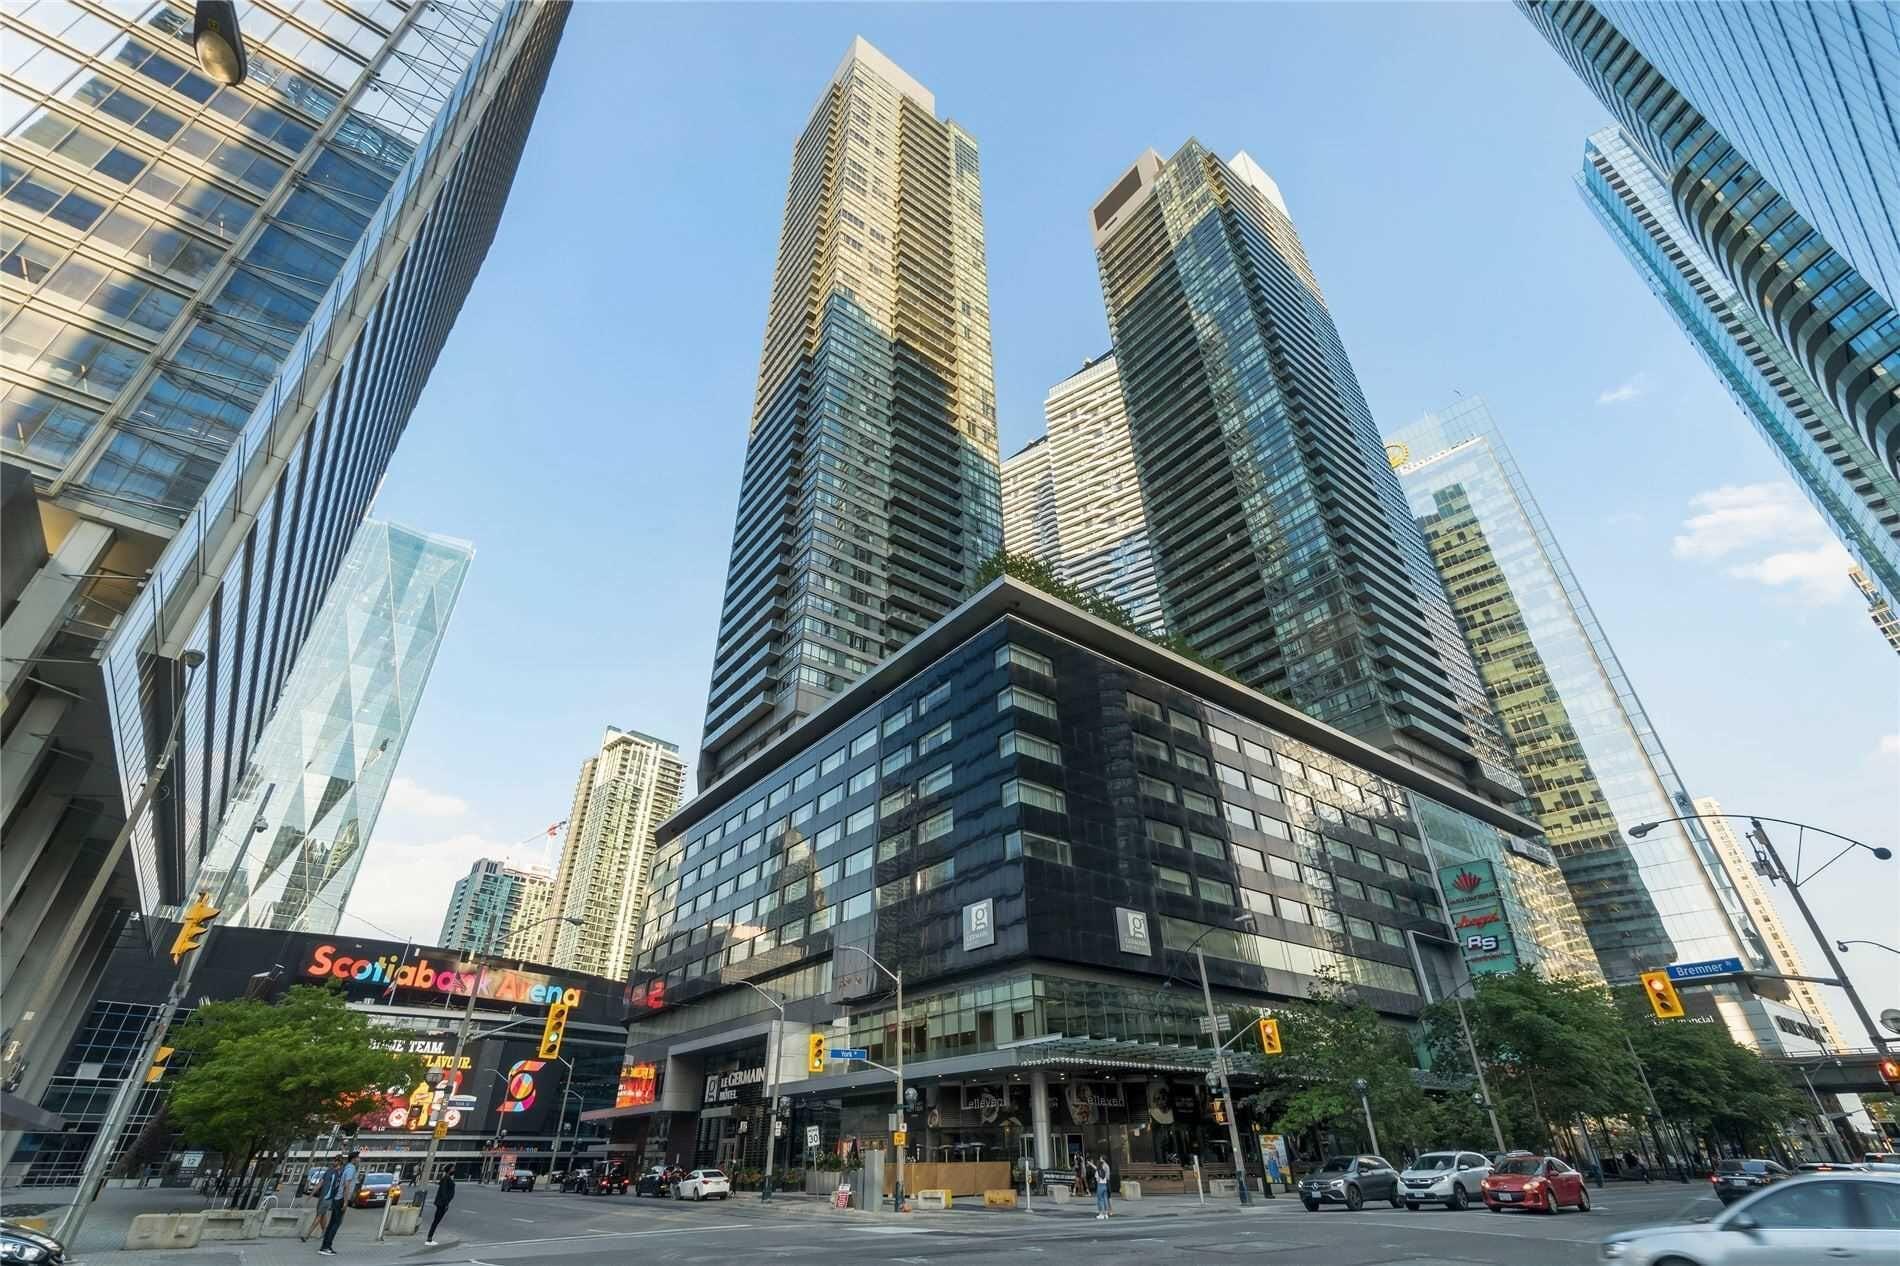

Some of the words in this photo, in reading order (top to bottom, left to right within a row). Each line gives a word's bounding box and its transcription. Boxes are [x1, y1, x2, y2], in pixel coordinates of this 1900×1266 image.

[1467, 936, 1497, 950] RS
[308, 944, 490, 995] Scotiabank
[495, 972, 581, 1007] Arena
[1676, 963, 1723, 977] Bremner
[729, 1067, 766, 1087] GERMAIN
[809, 1133, 819, 1144] 30
